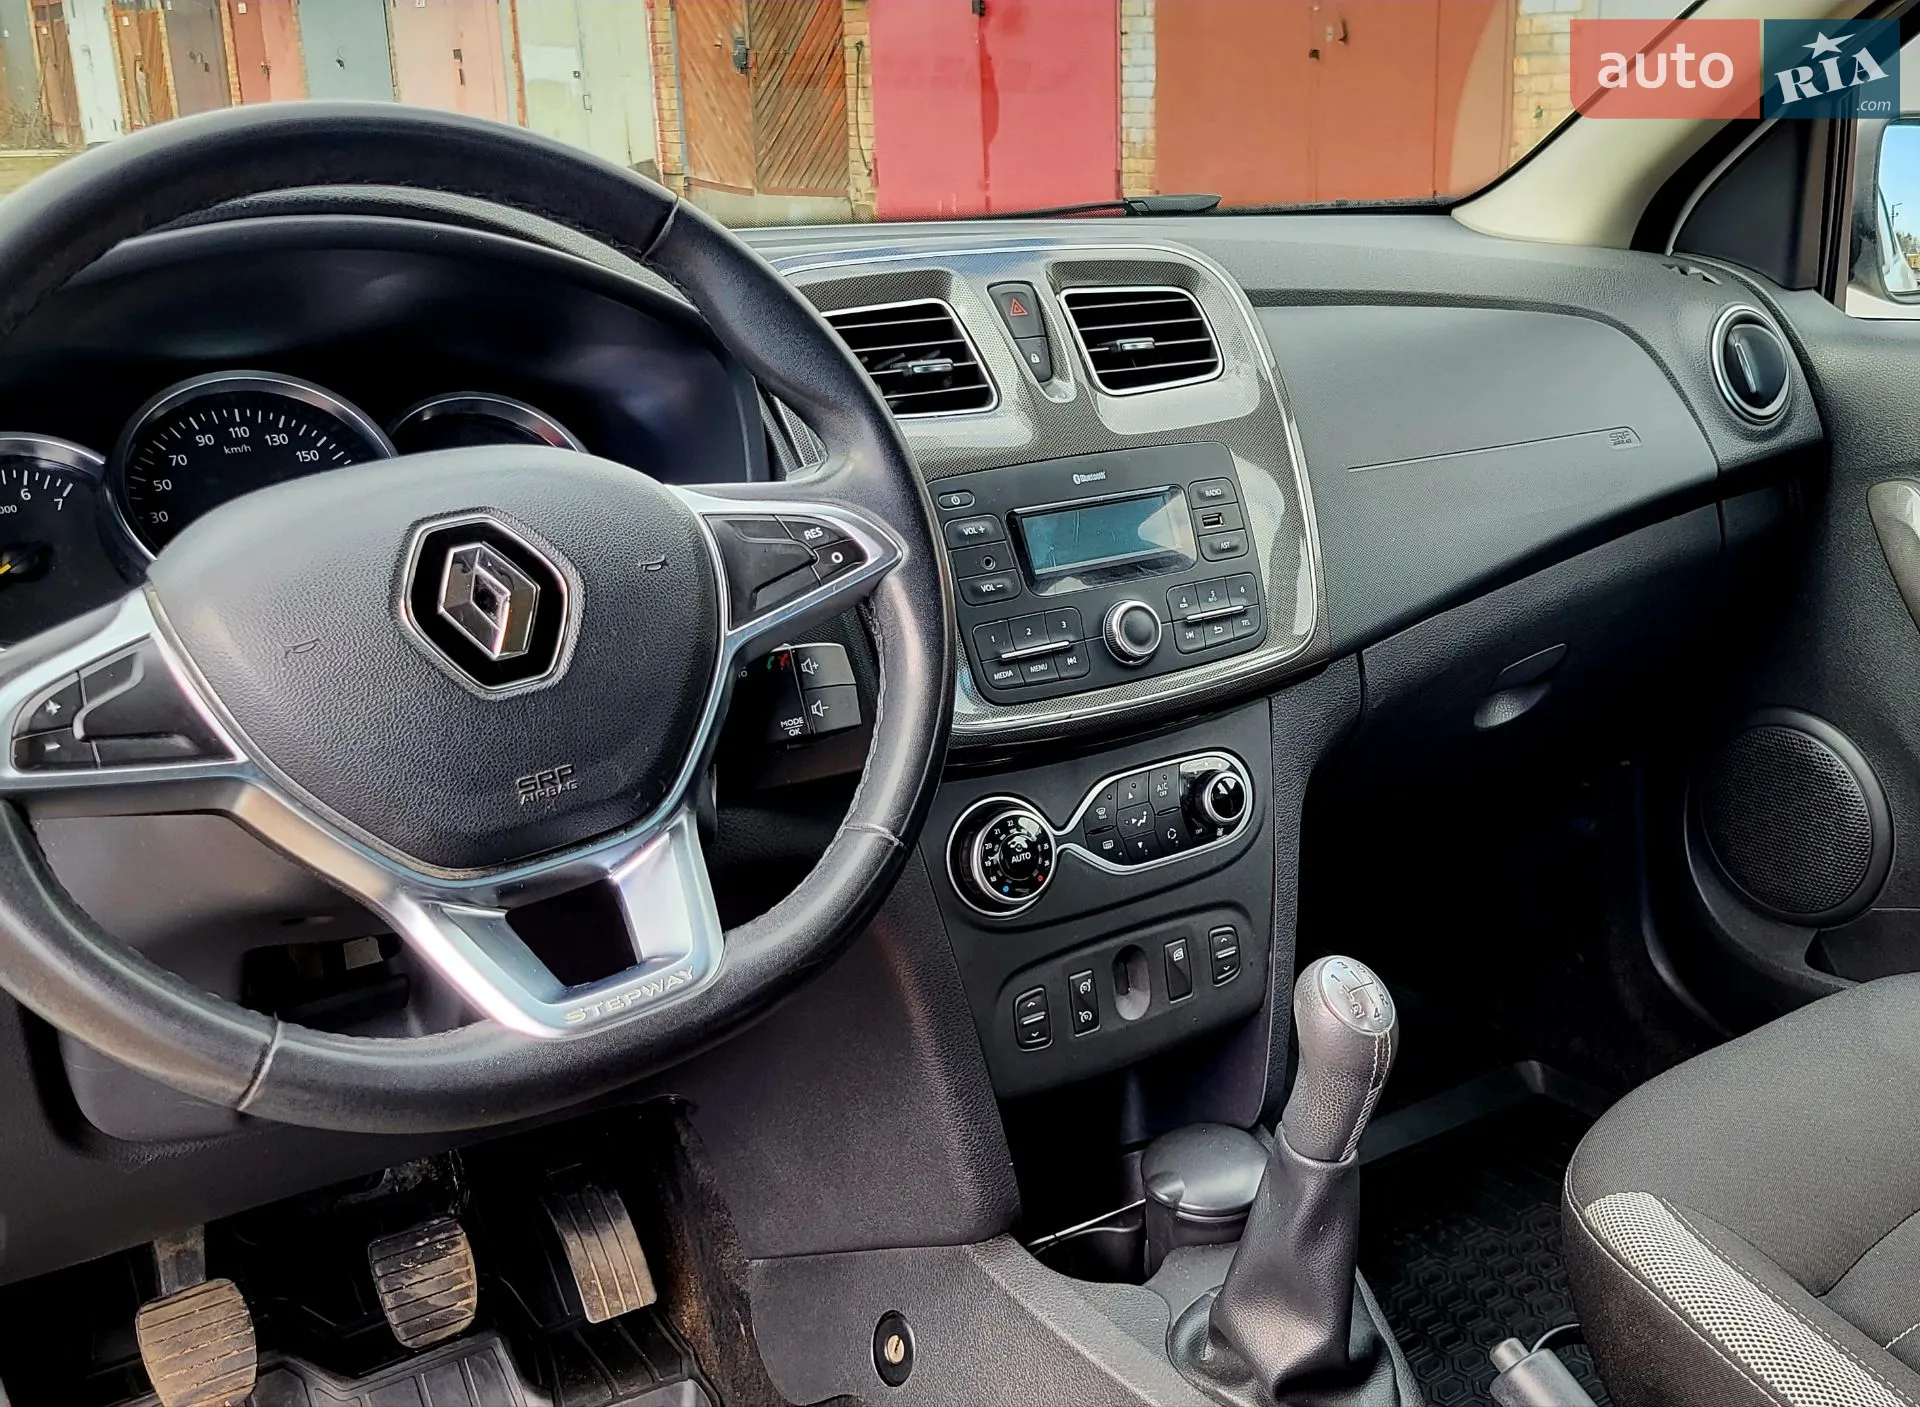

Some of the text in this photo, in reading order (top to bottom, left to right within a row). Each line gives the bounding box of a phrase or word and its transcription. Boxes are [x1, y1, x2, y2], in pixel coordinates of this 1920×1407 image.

[228, 426, 250, 439] 110
[196, 433, 215, 447] 90
[264, 433, 289, 447] 130
[224, 444, 252, 455] km/h
[168, 454, 188, 467] 70
[296, 449, 320, 464] 150
[153, 478, 173, 492] 50
[20, 488, 32, 501] 6
[1204, 488, 1222, 497] RADIO
[53, 498, 64, 511] 7
[150, 510, 169, 524] 30
[804, 527, 823, 541] RES
[962, 526, 979, 536] VOL
[1219, 541, 1231, 550] AST
[980, 583, 996, 593] VOL
[1061, 621, 1067, 629] 3
[1025, 628, 1032, 636] 2
[1029, 662, 1049, 673] MENU
[993, 670, 1014, 681] MEDIA
[780, 716, 805, 728] MODE
[788, 728, 802, 737] OK
[1156, 782, 1169, 793] A/C
[1011, 851, 1032, 864] AUTO
[565, 965, 694, 1024] STEPWAY
